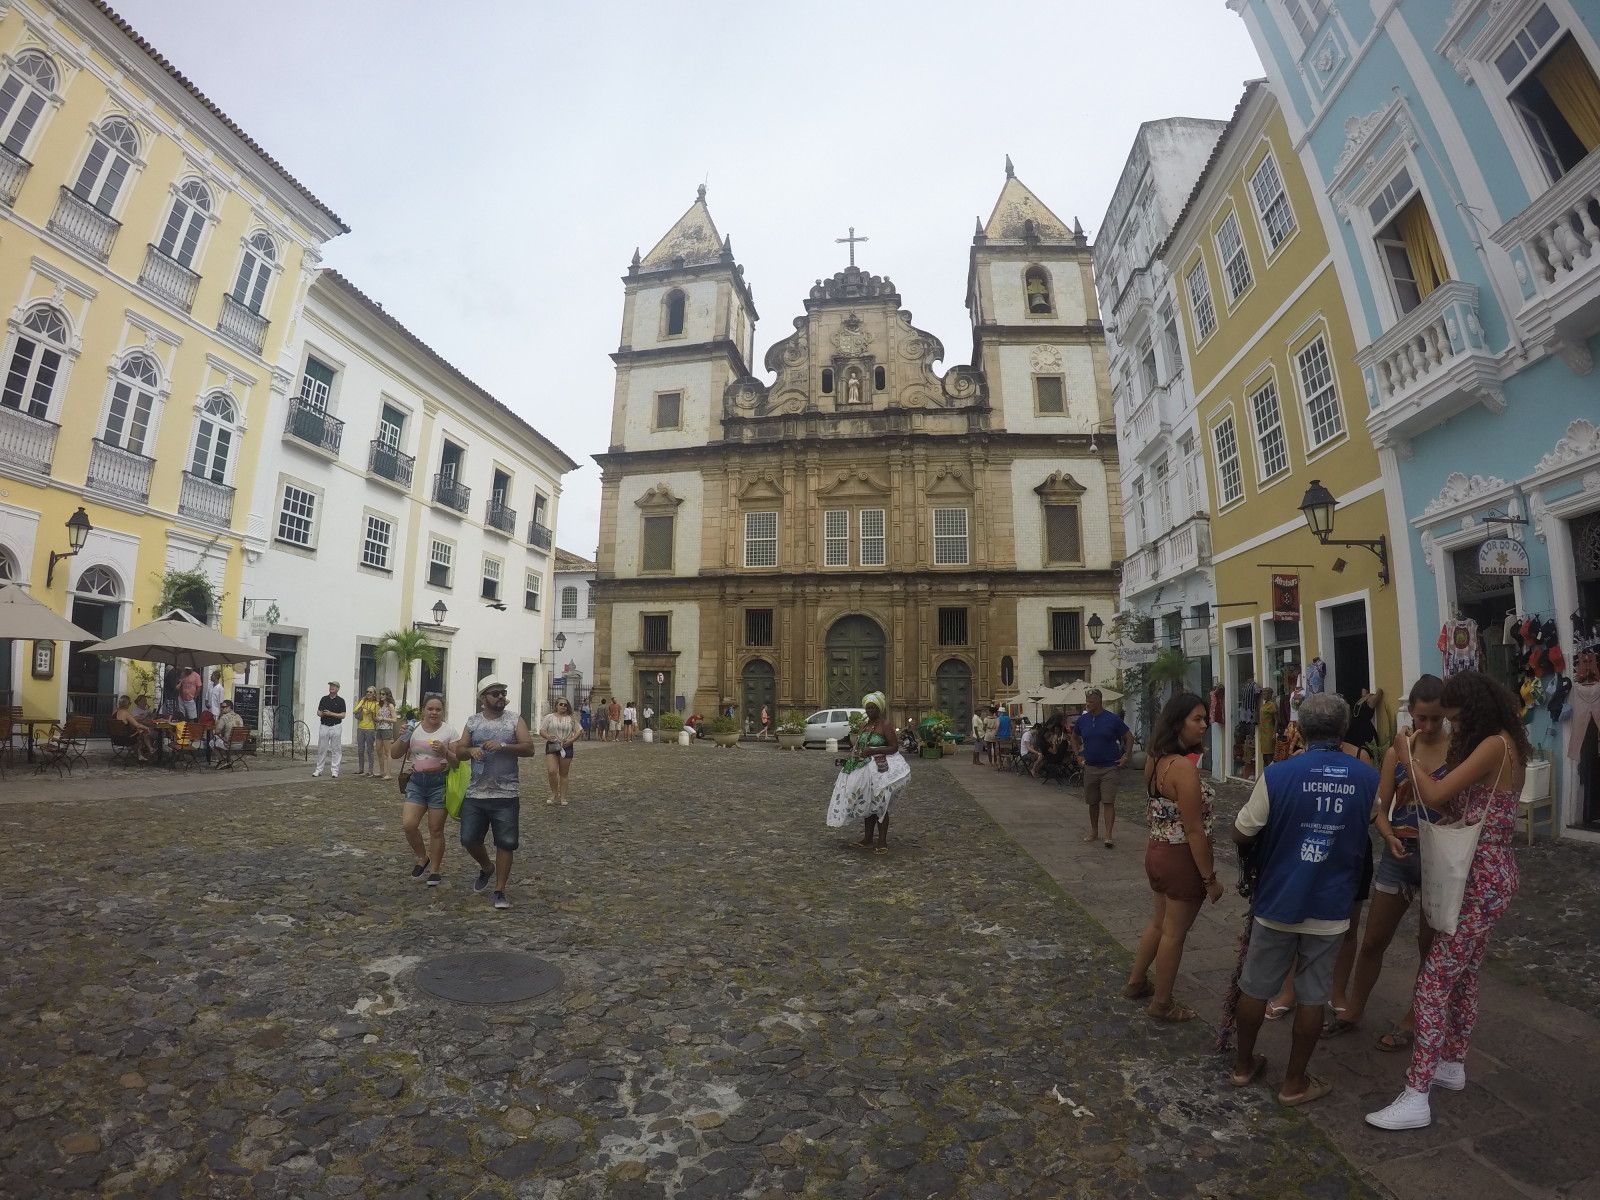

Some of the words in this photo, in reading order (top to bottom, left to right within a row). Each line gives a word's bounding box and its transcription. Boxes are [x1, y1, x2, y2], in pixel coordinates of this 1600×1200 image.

[1480, 541, 1497, 562] FLOR
[1499, 540, 1510, 550] DO
[1511, 543, 1526, 561] DIA
[1481, 567, 1498, 575] LOJA
[1498, 567, 1507, 575] DO
[1508, 567, 1529, 575] GORDO
[1302, 781, 1356, 795] LICENCIADO
[1315, 796, 1344, 814] 116
